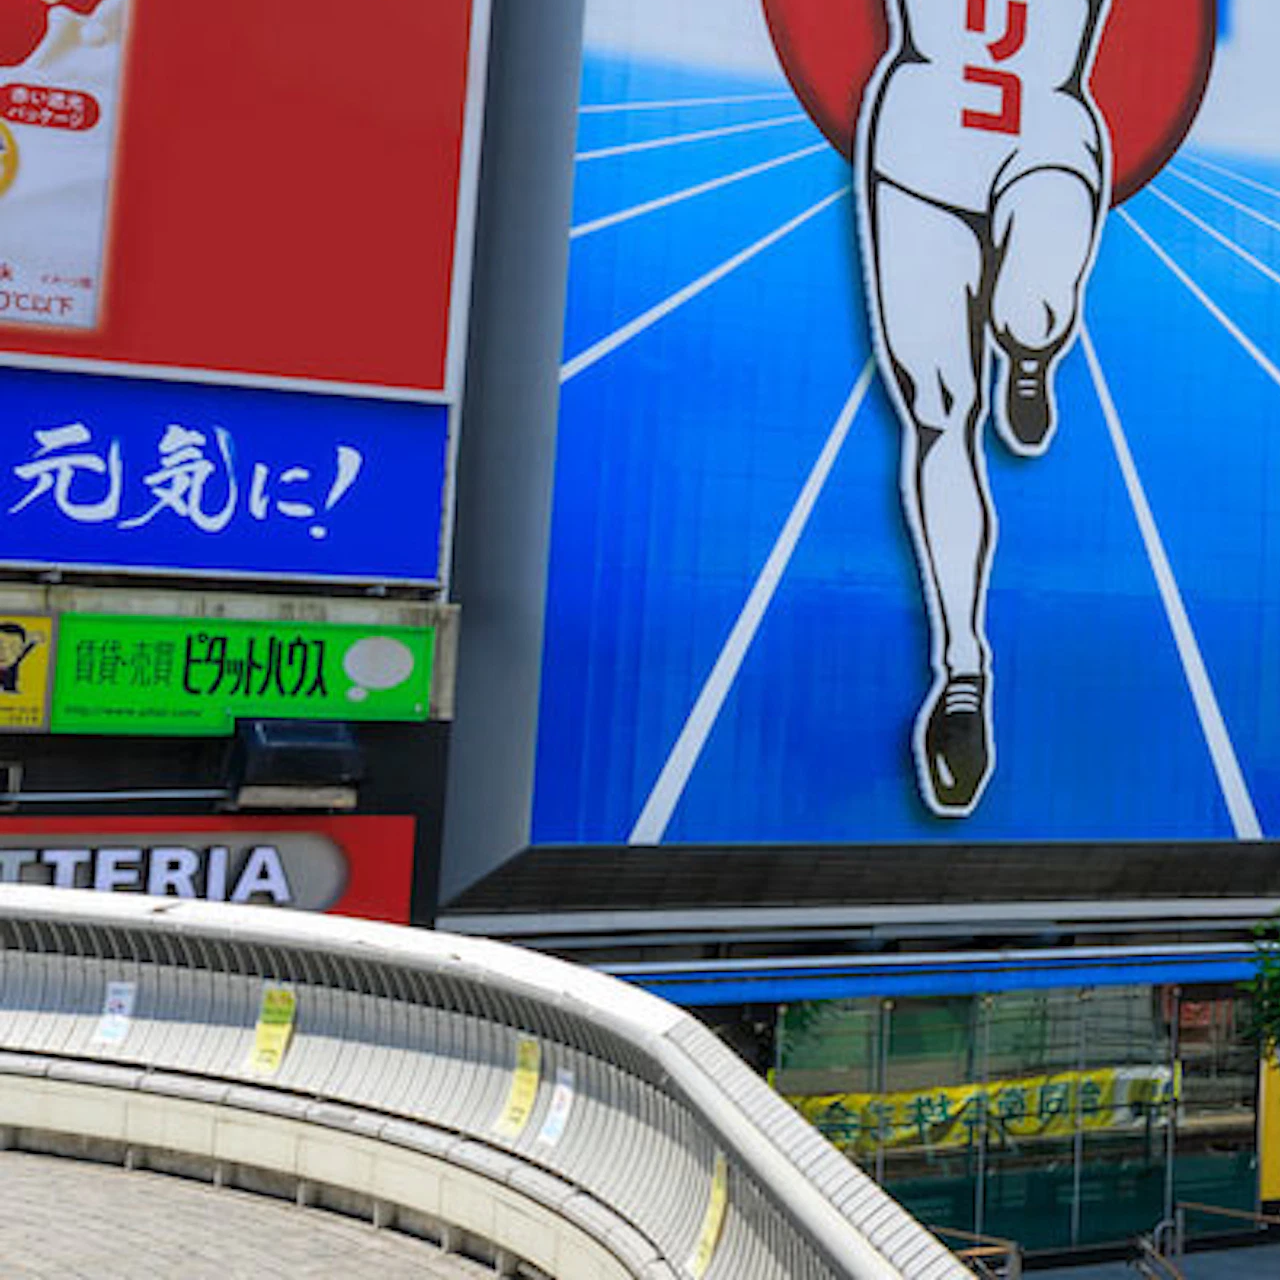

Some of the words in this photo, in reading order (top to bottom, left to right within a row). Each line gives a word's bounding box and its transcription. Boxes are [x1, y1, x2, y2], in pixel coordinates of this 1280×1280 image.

[8, 422, 364, 540] 元気に!
[182, 632, 329, 698] ピタットハウス
